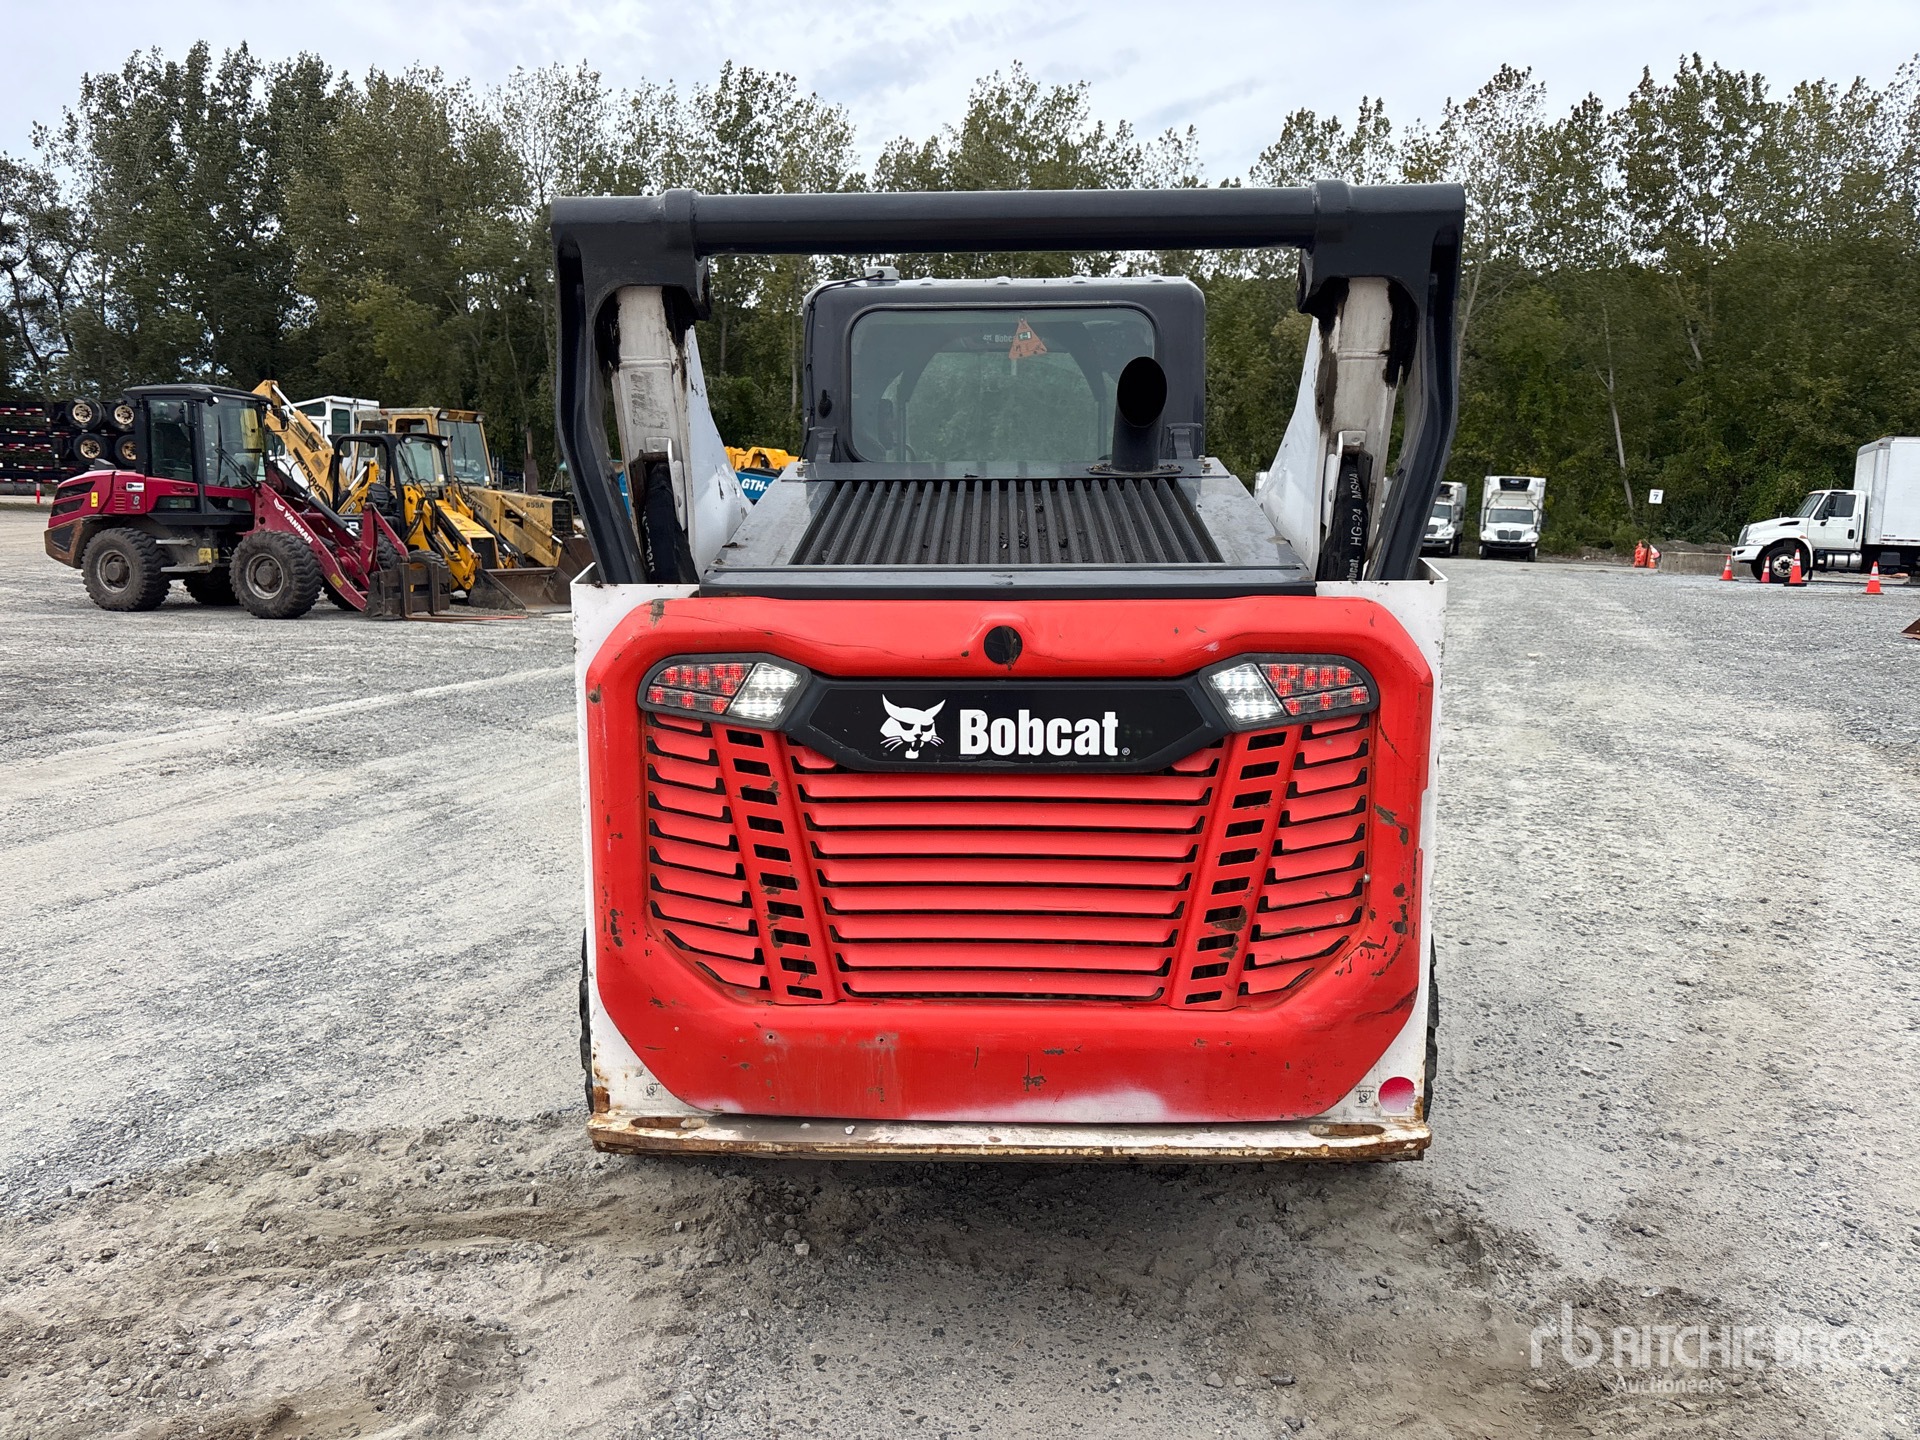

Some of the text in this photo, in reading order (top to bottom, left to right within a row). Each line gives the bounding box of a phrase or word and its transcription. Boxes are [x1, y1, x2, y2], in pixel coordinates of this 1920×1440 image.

[1349, 472, 1363, 500] MSHA
[283, 510, 314, 544] YANMAR
[1350, 508, 1363, 546] HG-24
[959, 709, 1119, 756] Bobcat
